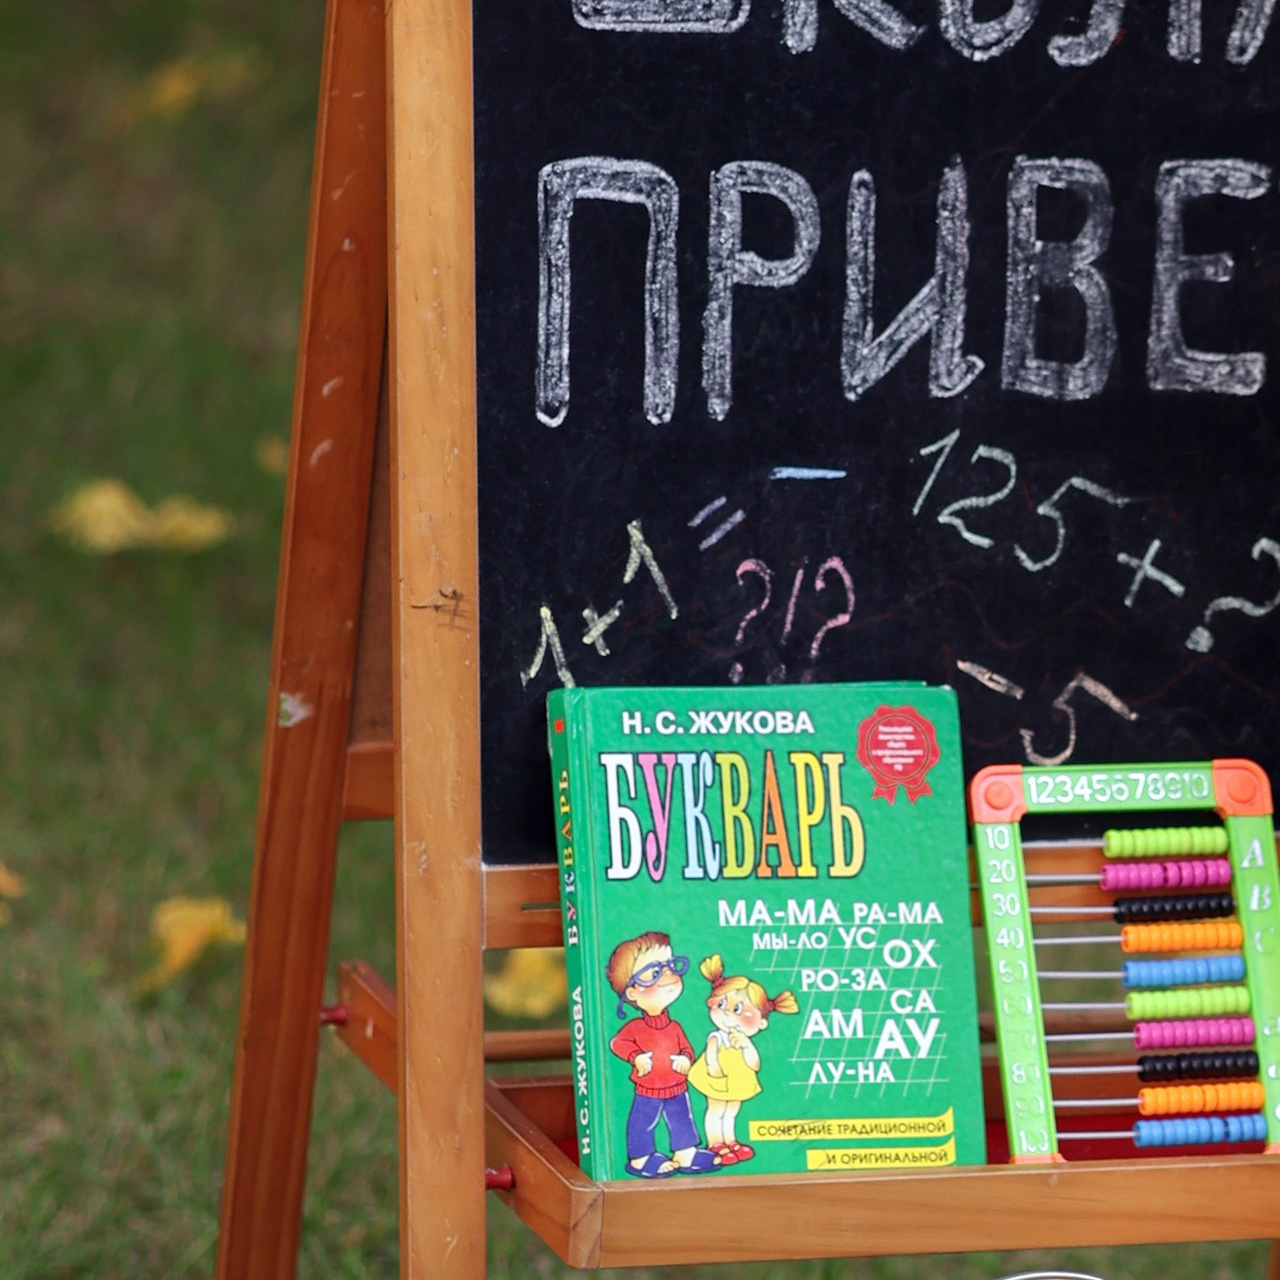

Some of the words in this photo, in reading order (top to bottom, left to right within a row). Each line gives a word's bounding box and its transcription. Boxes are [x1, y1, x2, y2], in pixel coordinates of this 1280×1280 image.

[621, 711, 651, 735] Н.
[655, 711, 684, 734] С.
[689, 710, 815, 734] ЖУКОВА
[599, 749, 866, 882] БУКВАРЬ
[985, 826, 1010, 850] 10
[558, 768, 580, 948] БУКВАРЬ
[1240, 837, 1264, 870] A
[988, 858, 1017, 884] 20
[992, 892, 1022, 918] 30
[1249, 883, 1273, 912] B
[718, 899, 842, 926] МА-МА
[853, 902, 943, 925] РА-МА
[752, 931, 828, 950] МЫ-ЛО
[837, 926, 877, 950] УС
[995, 926, 1025, 951] 40
[882, 938, 938, 969] ОХ
[801, 969, 887, 992] РО-ЗА
[890, 989, 937, 1014] СА
[803, 1008, 864, 1039] АМ
[572, 985, 589, 1097] ЖУКОВА
[874, 1018, 941, 1060] АУ
[808, 1061, 896, 1084] ЛУ-НА
[579, 1099, 590, 1126] С.
[581, 1129, 592, 1155] Н.
[757, 1123, 833, 1138] СОЧЕТАНИЕ
[837, 1121, 947, 1136] ТРАДИЦИОННОЙ
[826, 1154, 836, 1165] И
[840, 1150, 948, 1165] ОРИГИНАЛЬНОЙ
